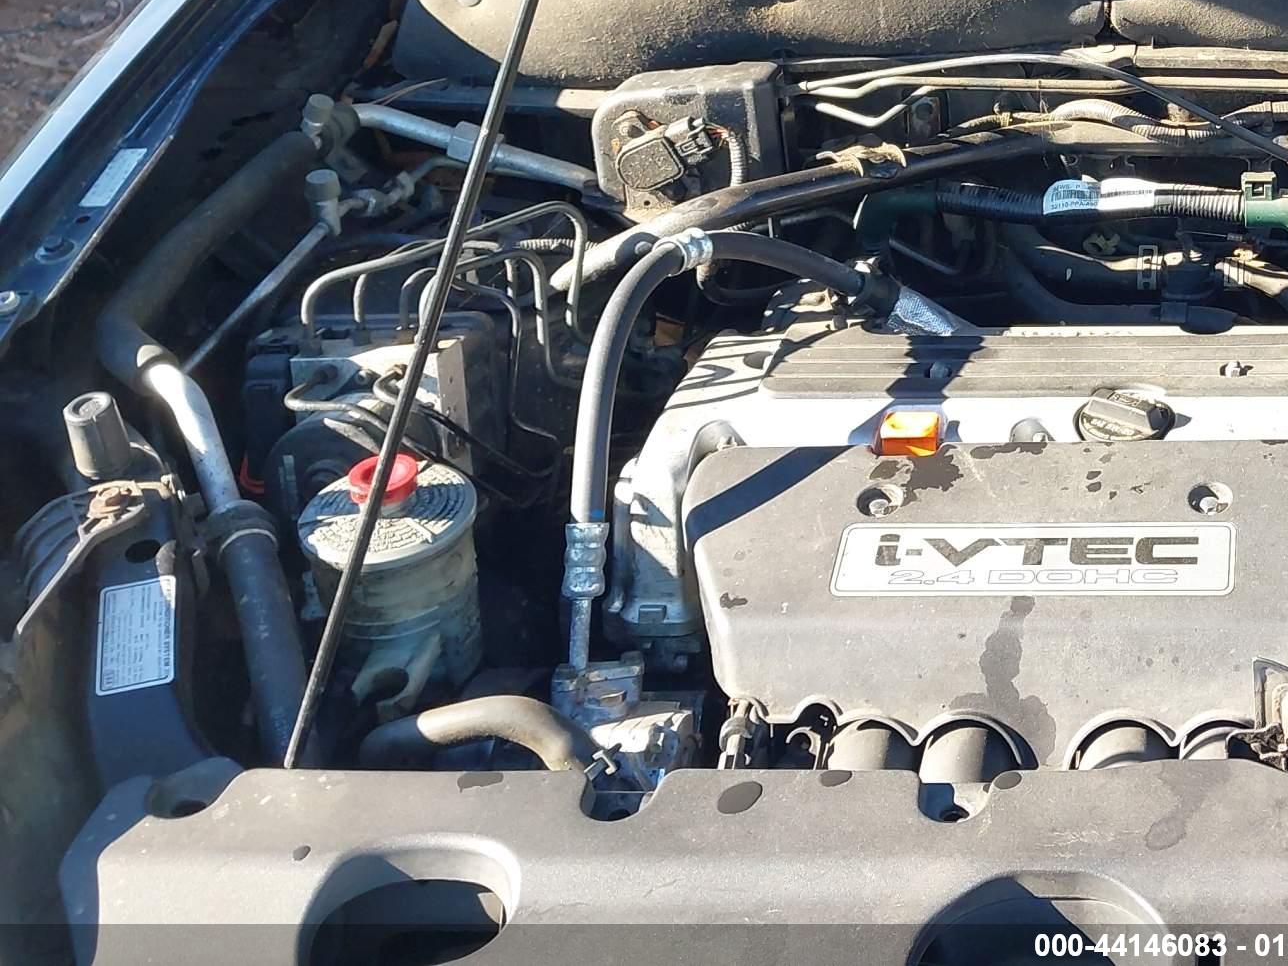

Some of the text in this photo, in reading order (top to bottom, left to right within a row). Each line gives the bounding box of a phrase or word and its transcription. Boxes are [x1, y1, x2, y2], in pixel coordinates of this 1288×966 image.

[875, 533, 1199, 567] i-VTEC
[888, 569, 1178, 586] 2.4 DOHC
[163, 641, 171, 667] SYSTEM
